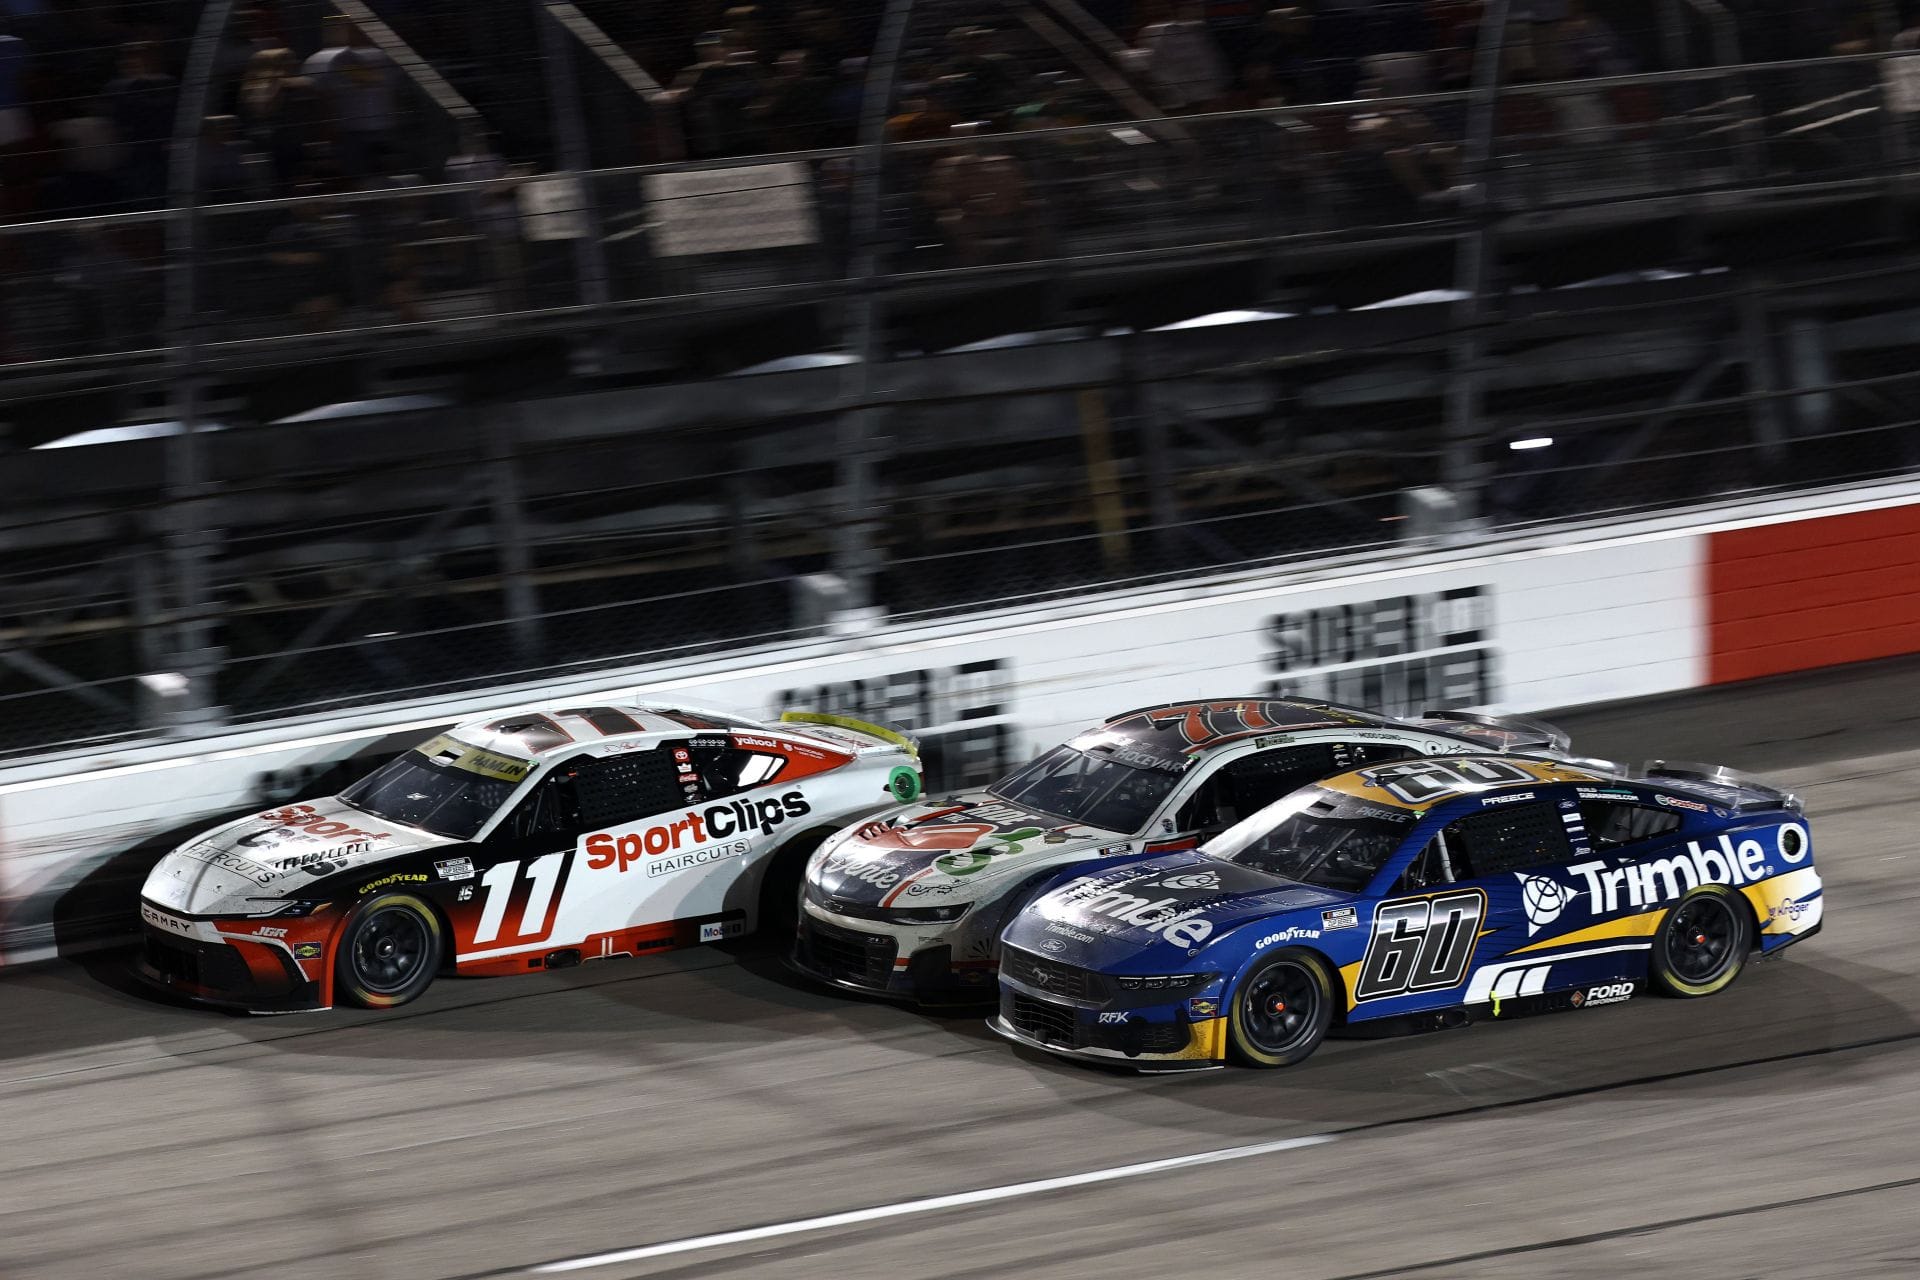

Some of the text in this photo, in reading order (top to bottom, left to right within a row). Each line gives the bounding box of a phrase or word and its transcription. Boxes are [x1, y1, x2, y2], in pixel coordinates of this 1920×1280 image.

[1146, 702, 1274, 744] 77
[734, 736, 777, 748] yahoo!
[467, 754, 527, 777] HAMLIN
[1114, 748, 1186, 773] HOCEVAR
[1481, 792, 1537, 807] PREECE
[1355, 806, 1413, 824] PREECE
[651, 841, 747, 871] HAIRCUTS
[358, 873, 428, 894] GOODYEAR
[1567, 833, 1766, 915] Trimble
[472, 851, 567, 945] 11
[251, 926, 288, 938] JGR
[1044, 923, 1095, 944] Trimble.com
[1255, 927, 1321, 950] GOODYEAR
[1357, 893, 1483, 999] 60
[1586, 982, 1636, 1001] FORD
[1097, 1011, 1130, 1023] RFK
